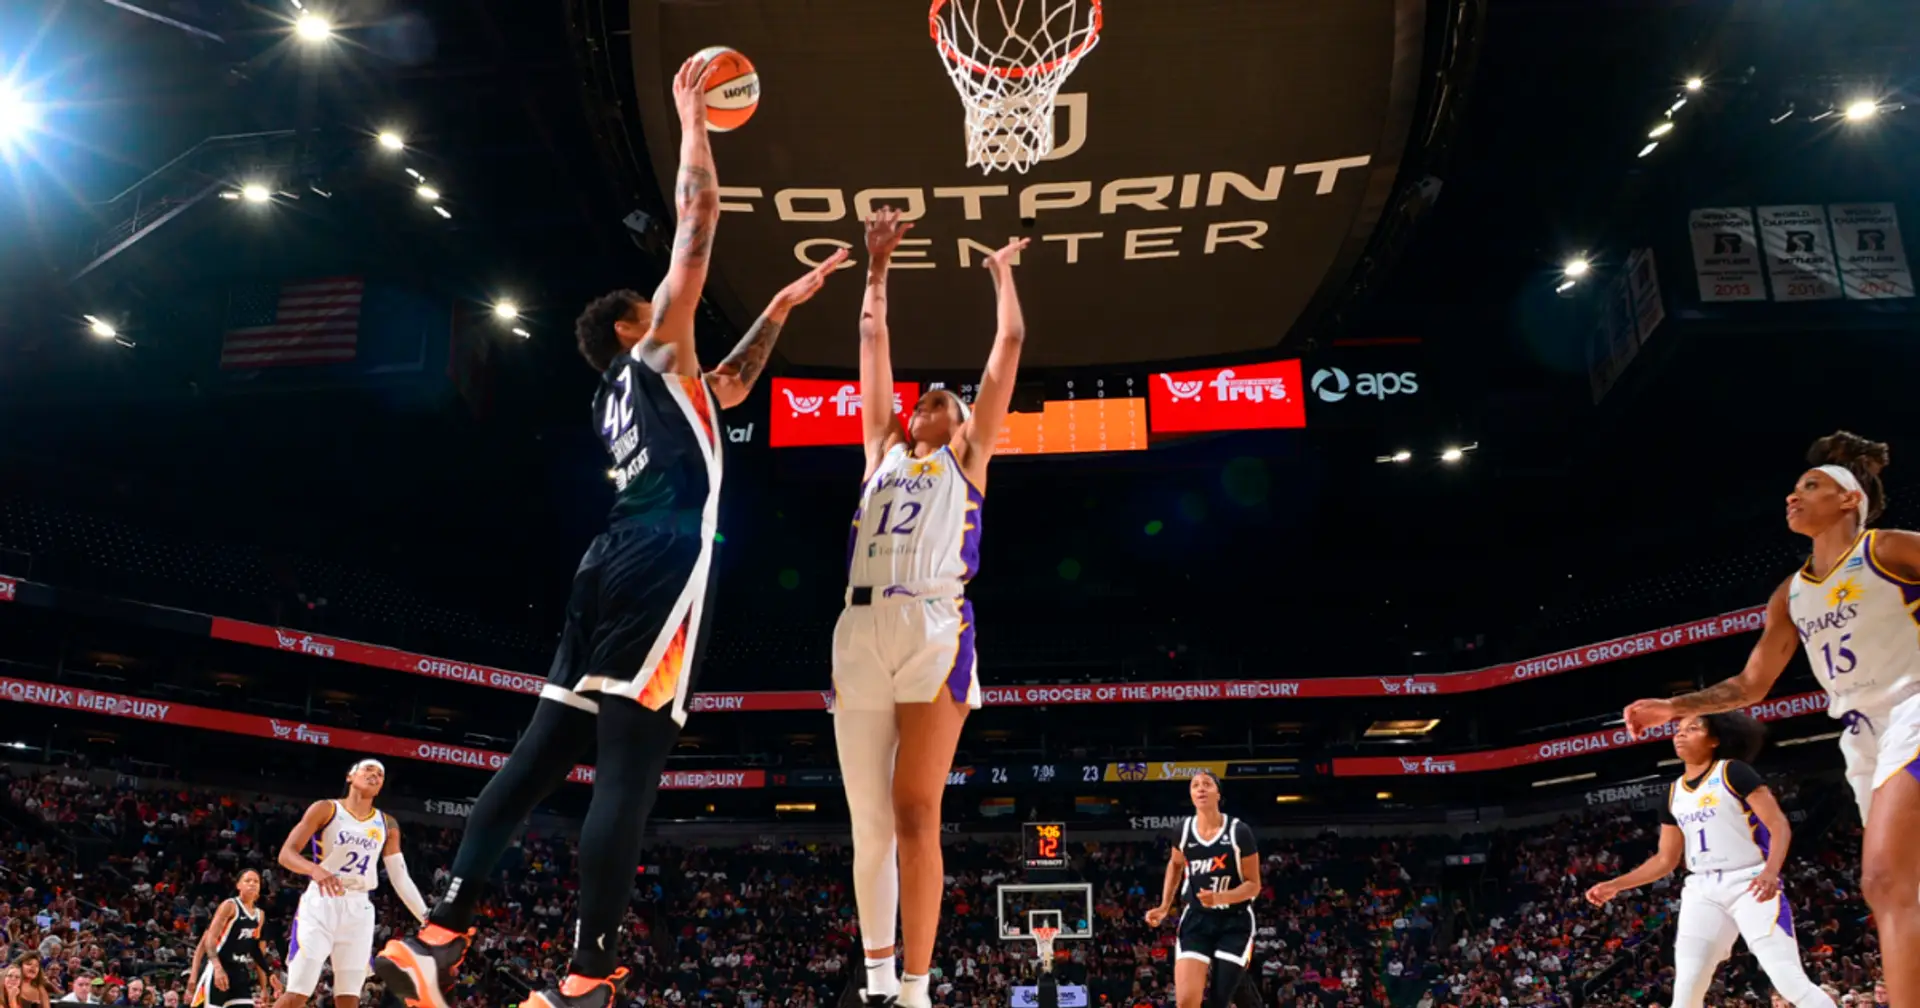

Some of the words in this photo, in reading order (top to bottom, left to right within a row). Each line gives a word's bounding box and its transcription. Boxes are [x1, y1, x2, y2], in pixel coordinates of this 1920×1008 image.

[718, 155, 1371, 222] FOOTPRINT
[793, 220, 1268, 269] CENTER
[1209, 369, 1287, 403] fry's
[1355, 371, 1419, 401] aps
[603, 364, 633, 447] 42
[727, 422, 754, 443] al
[872, 500, 922, 537] 12
[1514, 656, 1582, 678] OFFICIAL
[1586, 636, 1656, 662] GROCER
[1660, 629, 1683, 646] OF
[1688, 620, 1717, 640] THE
[1821, 633, 1858, 680] 15
[418, 659, 486, 683] OFFICIAL
[490, 672, 544, 693] GROCE
[689, 697, 744, 711] RCURY
[981, 690, 1022, 702] ICIAL
[1026, 688, 1092, 702] GROCER
[1096, 687, 1116, 699] OF
[1121, 686, 1147, 699] THE
[1152, 685, 1220, 698] PHOENIX
[1226, 683, 1299, 698] MERCURY
[77, 692, 169, 719] MERCURY
[1752, 692, 1831, 719] PHOENIX
[418, 744, 486, 766] OFFICIAL
[1539, 735, 1609, 758] OFFICIAL
[576, 767, 596, 781] TH
[675, 772, 745, 787] MERCURY
[992, 767, 1008, 783] 24
[1082, 765, 1099, 783] 23
[1039, 838, 1057, 857] 12
[1697, 828, 1711, 852] 1
[339, 851, 371, 876] 24
[1190, 853, 1228, 875] PHX
